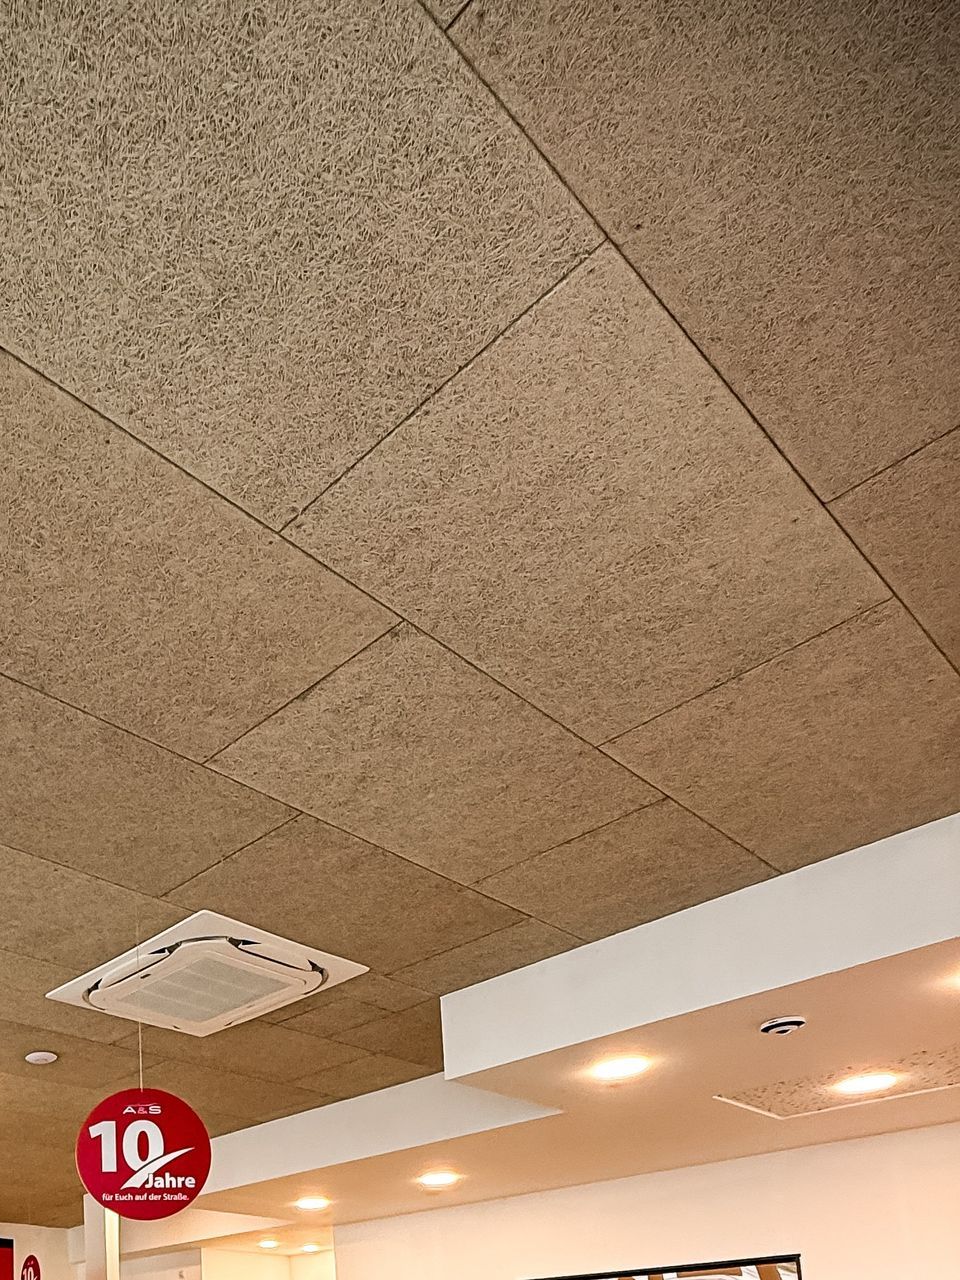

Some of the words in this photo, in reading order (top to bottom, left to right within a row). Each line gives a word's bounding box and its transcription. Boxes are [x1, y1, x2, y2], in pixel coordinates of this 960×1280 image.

[88, 1119, 165, 1173] 10
[144, 1171, 196, 1189] Jahre
[102, 1192, 114, 1201] für
[114, 1192, 134, 1201] Euch
[134, 1192, 148, 1201] auf
[148, 1192, 162, 1201] der
